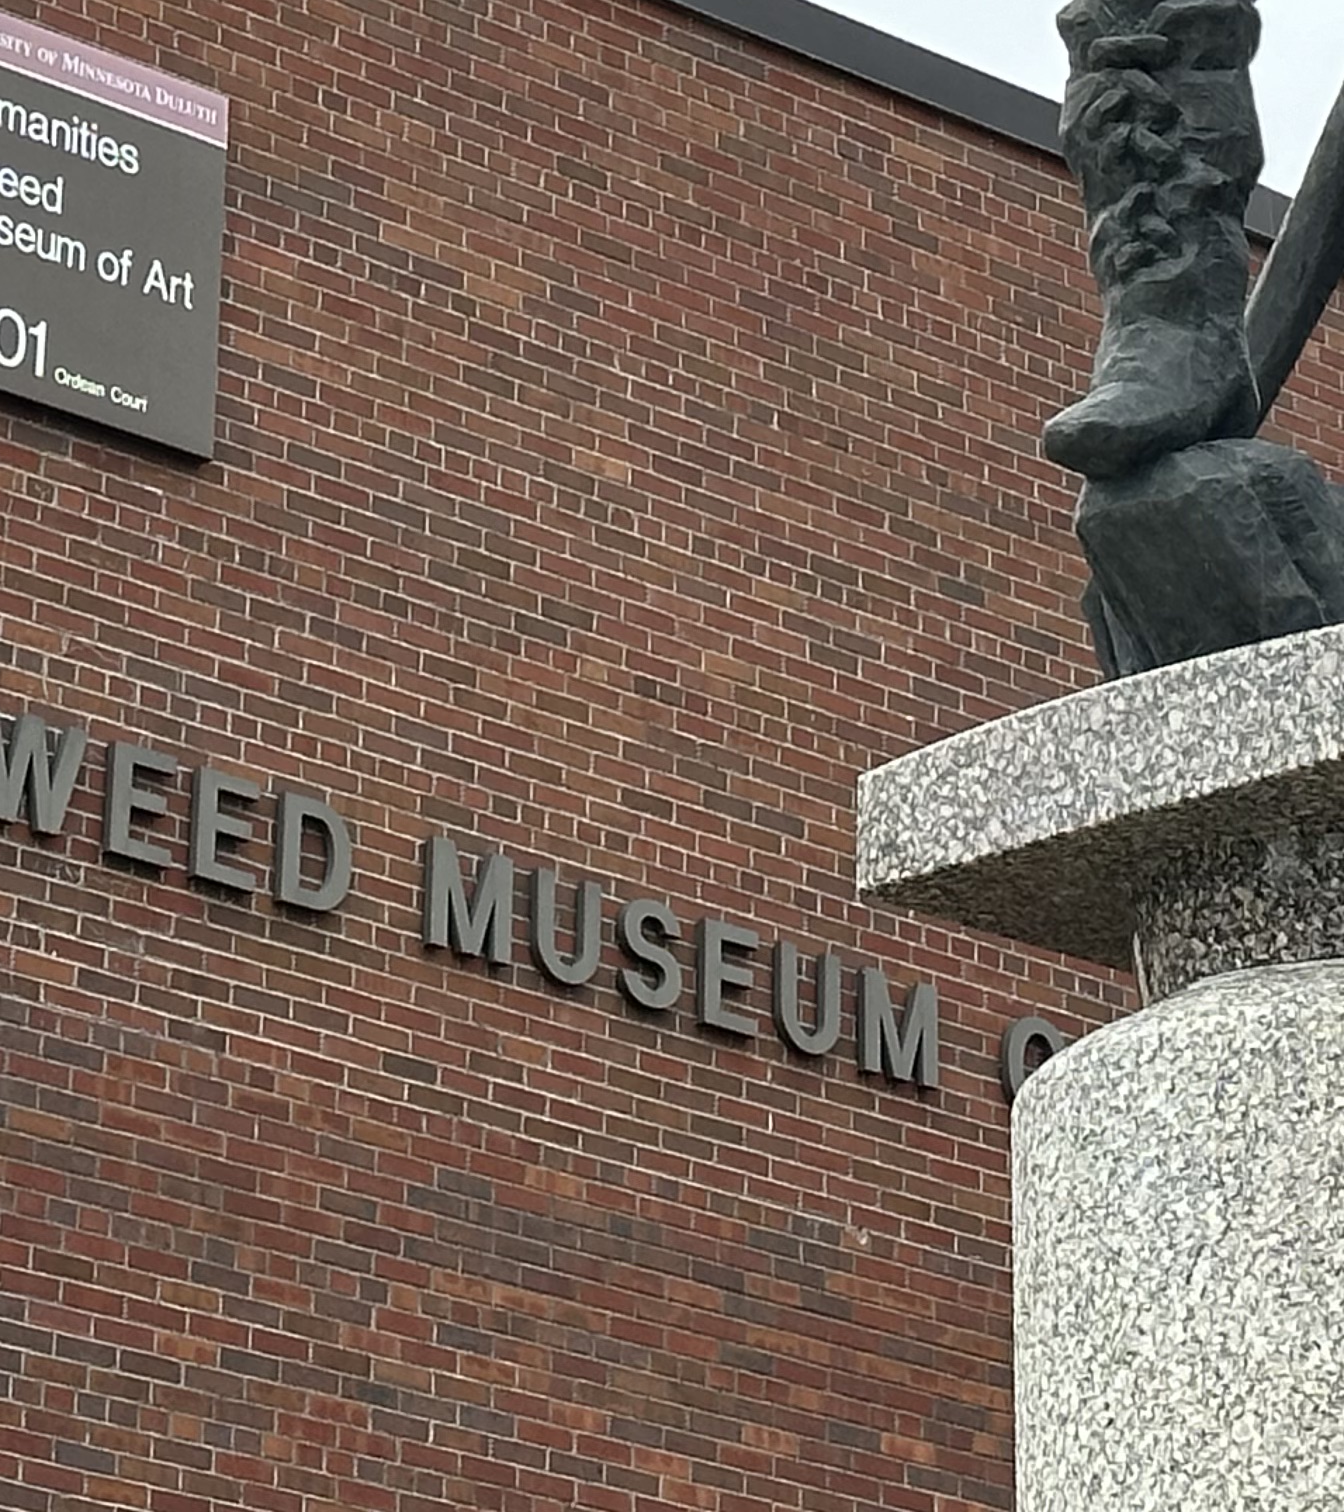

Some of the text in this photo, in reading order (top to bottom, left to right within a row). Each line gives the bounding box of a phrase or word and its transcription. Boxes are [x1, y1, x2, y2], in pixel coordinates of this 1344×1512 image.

[61, 52, 151, 102] MINNESOTA
[156, 88, 219, 125] DULUTH
[97, 249, 133, 286] of
[142, 260, 194, 309] Art
[54, 367, 105, 397] Ordean
[110, 385, 147, 413] Court
[424, 836, 940, 1088] MUSEUM
